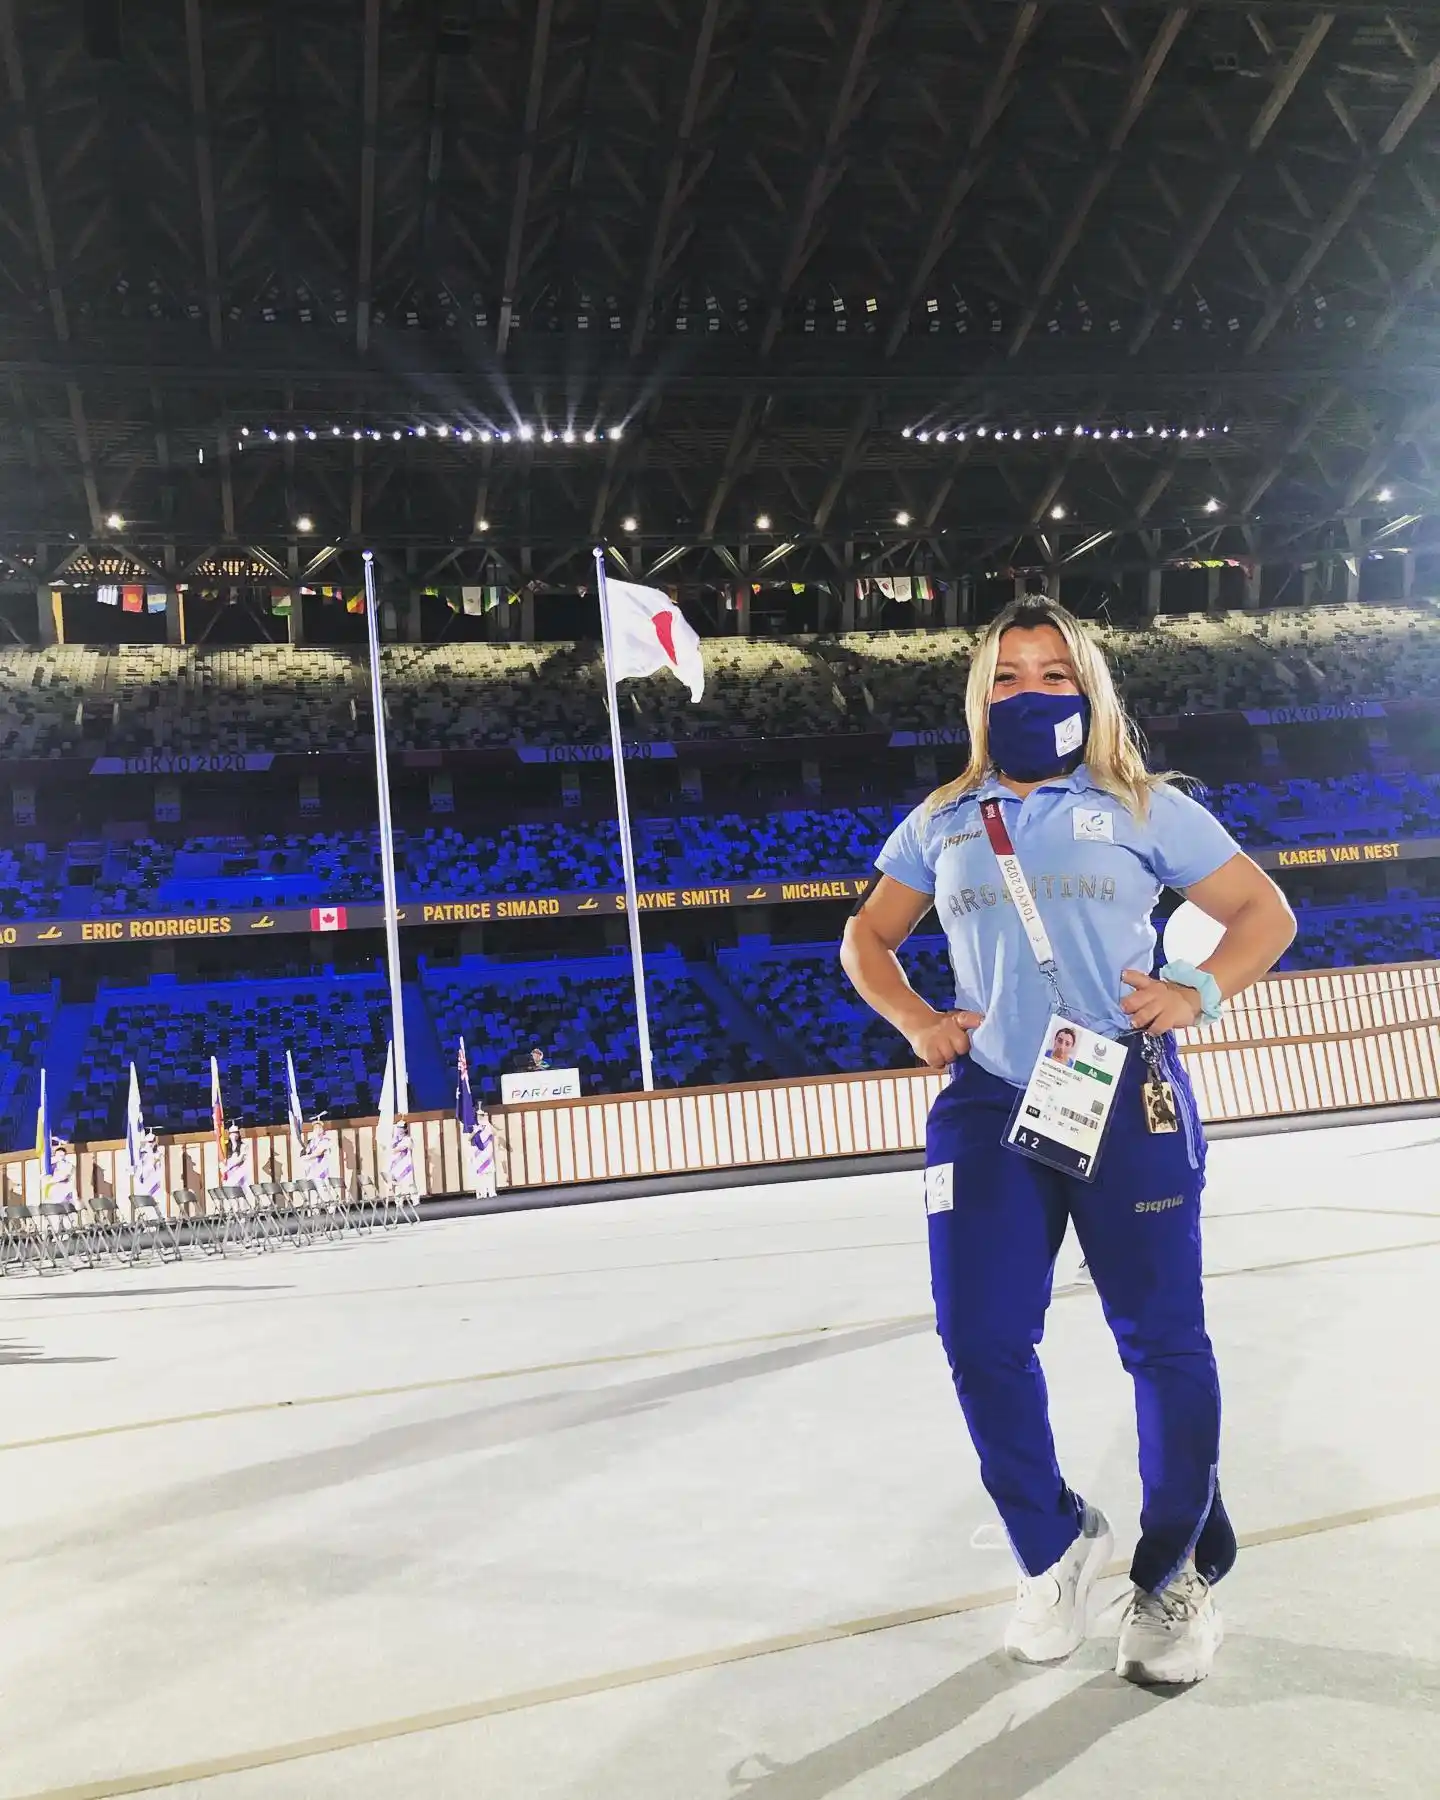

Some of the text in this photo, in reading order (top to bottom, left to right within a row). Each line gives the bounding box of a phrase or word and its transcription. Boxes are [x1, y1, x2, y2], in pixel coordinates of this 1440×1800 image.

[124, 753, 246, 774] TOKYO 2020
[545, 743, 651, 763] TOKYO 020
[1278, 843, 1401, 866] KAREN VAN NEST
[615, 888, 731, 910] SAYNE SMITH
[782, 882, 850, 901] MICHAEL
[423, 898, 560, 922] PATRICE SIMARD
[1014, 886, 1036, 922] TOKYO
[81, 922, 124, 941] ERIC
[129, 916, 232, 938] RODRIGUES
[1018, 1132, 1041, 1150] A 2
[1077, 1157, 1087, 1170] R
